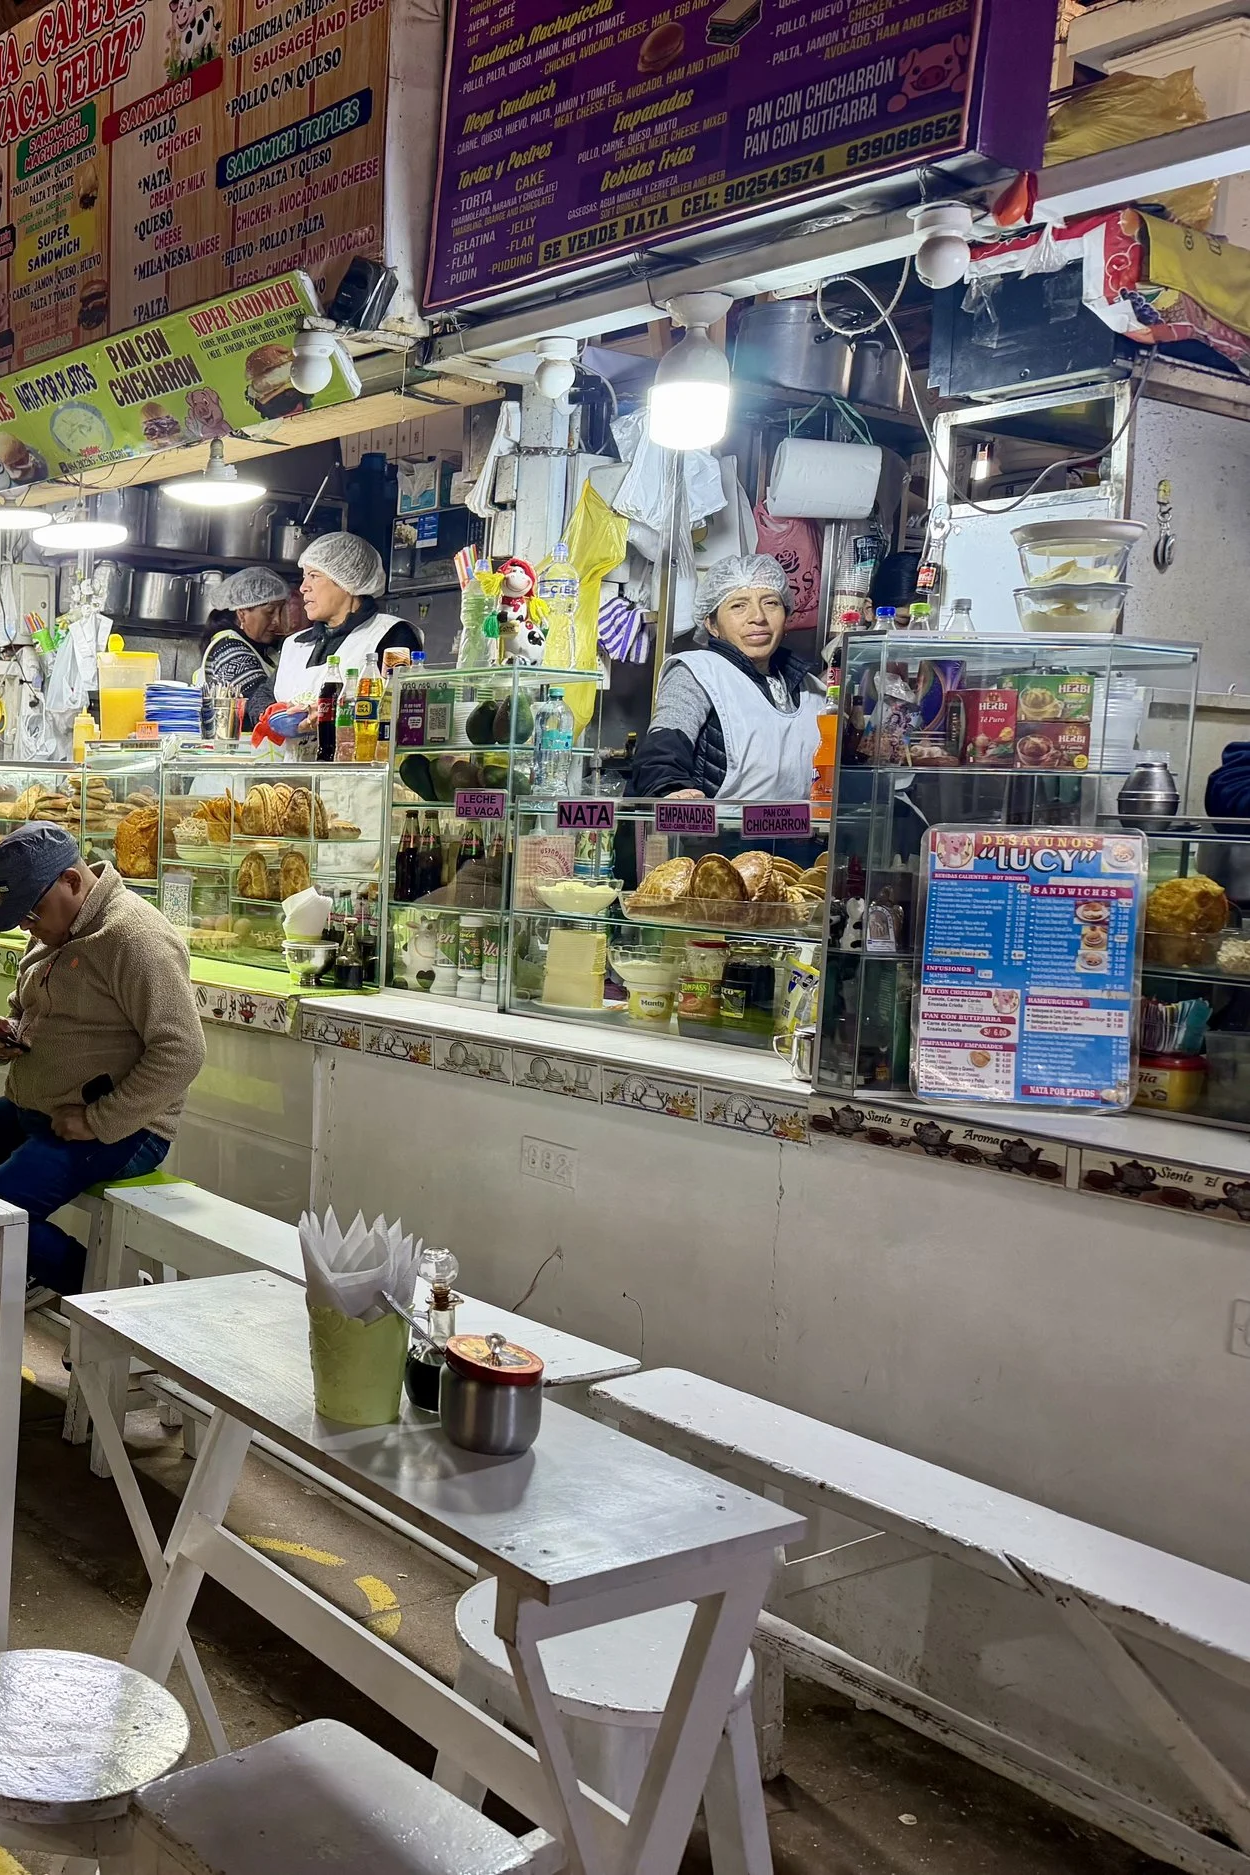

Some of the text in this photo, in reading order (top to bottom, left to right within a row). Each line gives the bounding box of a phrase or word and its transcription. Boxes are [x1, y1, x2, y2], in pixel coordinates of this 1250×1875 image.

[285, 8, 302, 30] C/N
[562, 11, 626, 50] HUEVO TOMATE
[775, 1, 844, 38] POLLO, HUEVO
[876, 0, 968, 43] HAM AND CHEESE
[253, 10, 346, 73] SAUSAGE AND
[468, 33, 525, 74] Sandwich
[772, 13, 885, 67] PALTA, JAMON QUESO
[271, 46, 341, 100] C/N QUESO
[706, 44, 741, 73] TOMATO
[118, 78, 191, 134] SANDWICH
[462, 79, 557, 135] Mega Sandwich
[554, 80, 617, 116] JAMON TOMATE
[746, 56, 896, 131] PAN CON CHICHARRÓN
[613, 89, 694, 134] Empanadas
[654, 117, 678, 136] MIXTO
[703, 112, 728, 131] MIXED
[743, 93, 877, 159] PAN CON BUTIFARRA
[29, 112, 81, 152] SANDWICH
[157, 125, 201, 160] CHICKEN
[226, 98, 360, 181] SANDWICH TRIPLES
[299, 147, 332, 179] QUESO
[457, 141, 553, 190] Tortas y Postres
[600, 160, 655, 192] Bebidas
[150, 171, 206, 210] CREAM OF MILK
[236, 158, 379, 232] CHICKEN AVOCADO AND CHEESE
[515, 169, 546, 192] CAKE
[543, 113, 961, 262] SE VENDE NATA CEL: 902543574 939088652
[650, 174, 678, 192] CERVEZA
[460, 190, 492, 212] TORTA
[38, 224, 69, 250] SUPER
[154, 226, 182, 251] CHEESE
[259, 213, 325, 254] POLLO PALTA
[328, 225, 376, 258] AVOCADO
[453, 230, 496, 255] GELATINA
[28, 238, 80, 272] SANDWICH
[451, 253, 475, 270] FLAN
[450, 267, 478, 286] PUDIN
[188, 305, 232, 337] SUPER
[227, 280, 300, 323] SANDWICH
[105, 339, 141, 373] PAN
[133, 327, 172, 362] CON
[13, 362, 98, 412] NATA POR PLATOS
[108, 354, 204, 407] CHICHARRON
[550, 584, 577, 595] CIEL
[1058, 684, 1090, 694] HERBI
[979, 702, 1008, 711] HERBI
[1058, 735, 1086, 743] HERBI
[458, 806, 501, 817] DE VACA
[463, 794, 496, 804] LECHE
[559, 804, 612, 826] NATA
[763, 808, 791, 817] PAN CON
[659, 806, 713, 825] EMPANADAS
[746, 818, 808, 832] CHICHARRON
[982, 834, 1095, 848] DESAYUNOS
[1034, 886, 1117, 897] SANDWICHES
[1028, 998, 1083, 1006] HAMBURGUESAS
[1030, 1086, 1095, 1097] NATA POR PLATOS
[864, 1110, 1000, 1145] Siente El Aroma
[1156, 1166, 1220, 1187] Siente El
